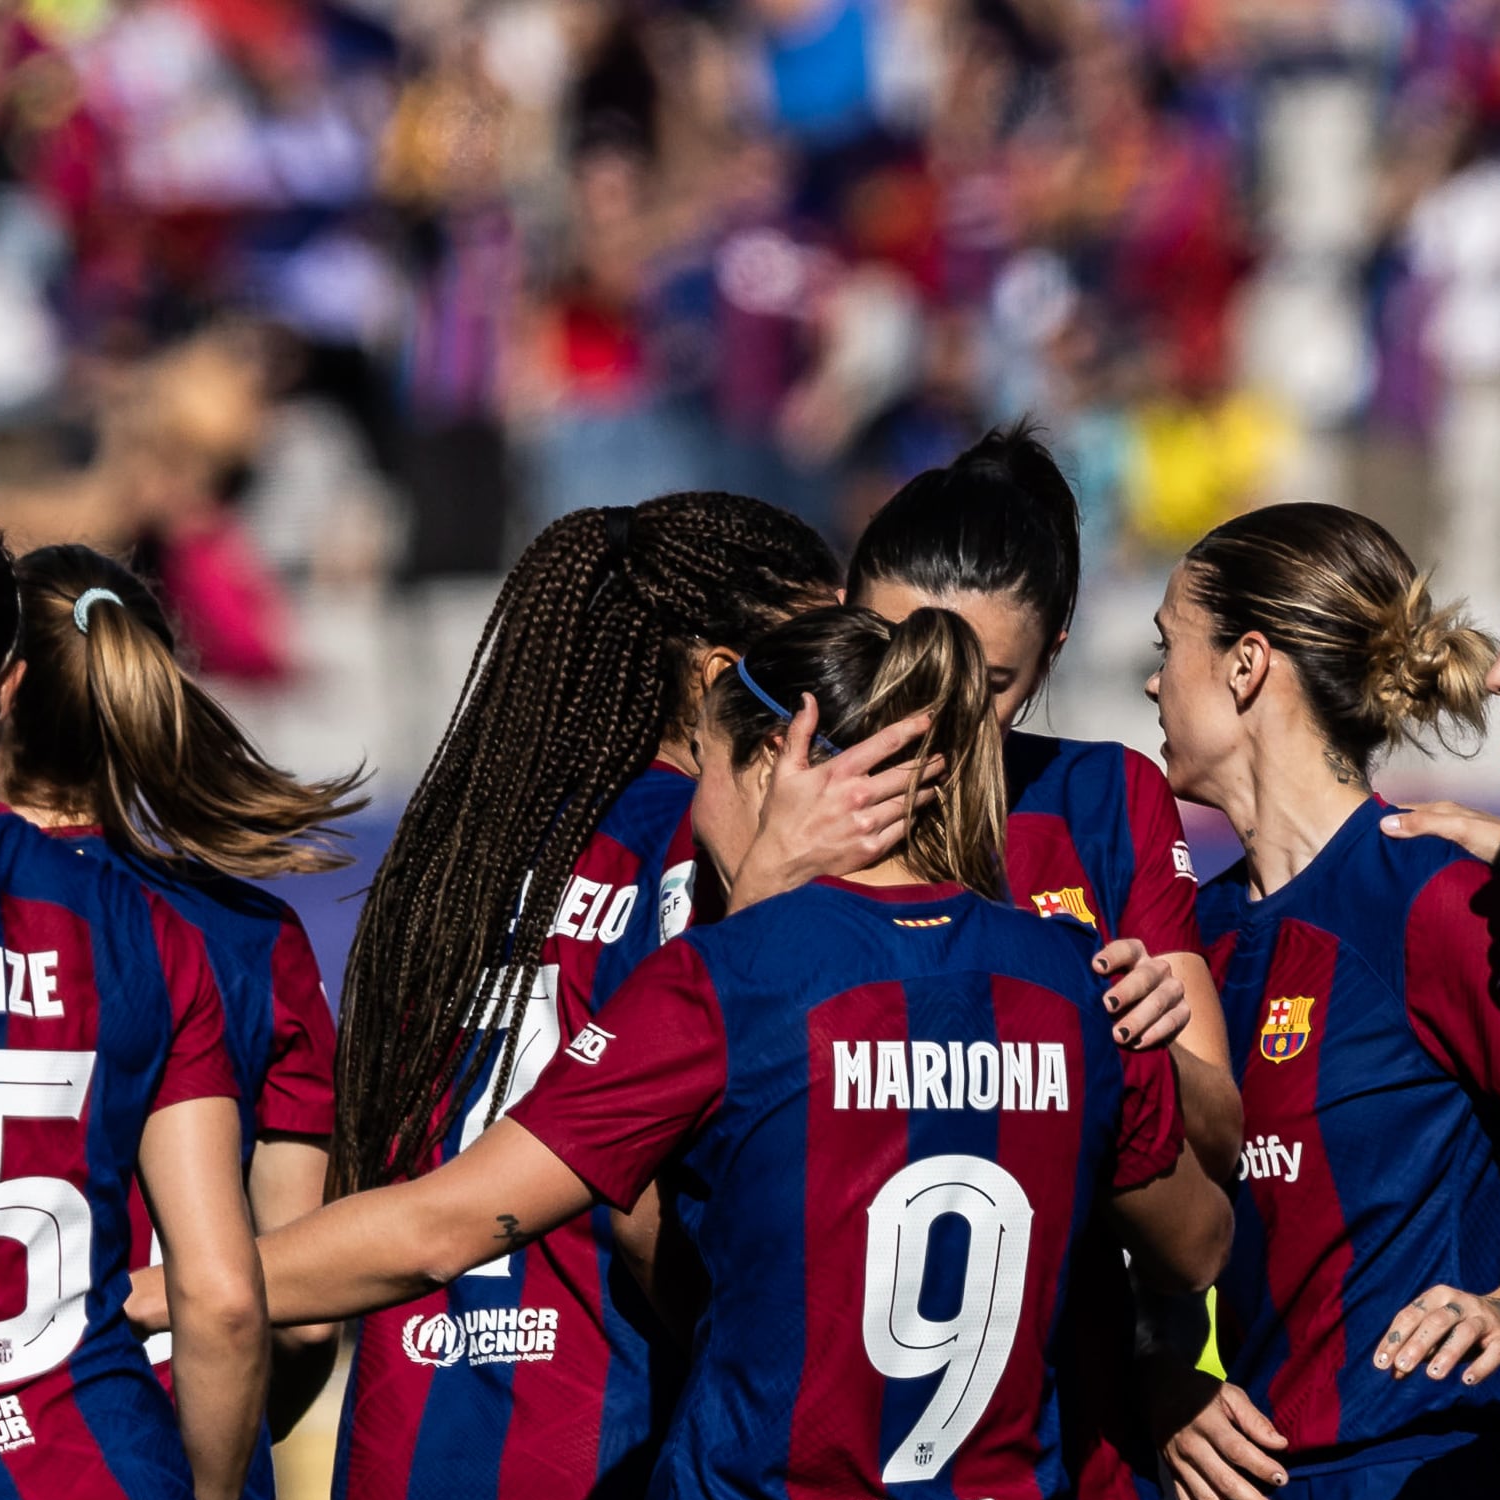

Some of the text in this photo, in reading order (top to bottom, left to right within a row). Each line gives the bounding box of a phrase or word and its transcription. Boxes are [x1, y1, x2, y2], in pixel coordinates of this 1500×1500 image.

[832, 1040, 1070, 1112] MARIONA
[464, 1307, 560, 1334] UNHCR
[862, 1154, 1035, 1484] 9
[467, 1329, 557, 1357] ACNUR
[488, 1353, 522, 1364] Refugee
[522, 1352, 554, 1363] Agency
[3, 1436, 36, 1452] Agency
